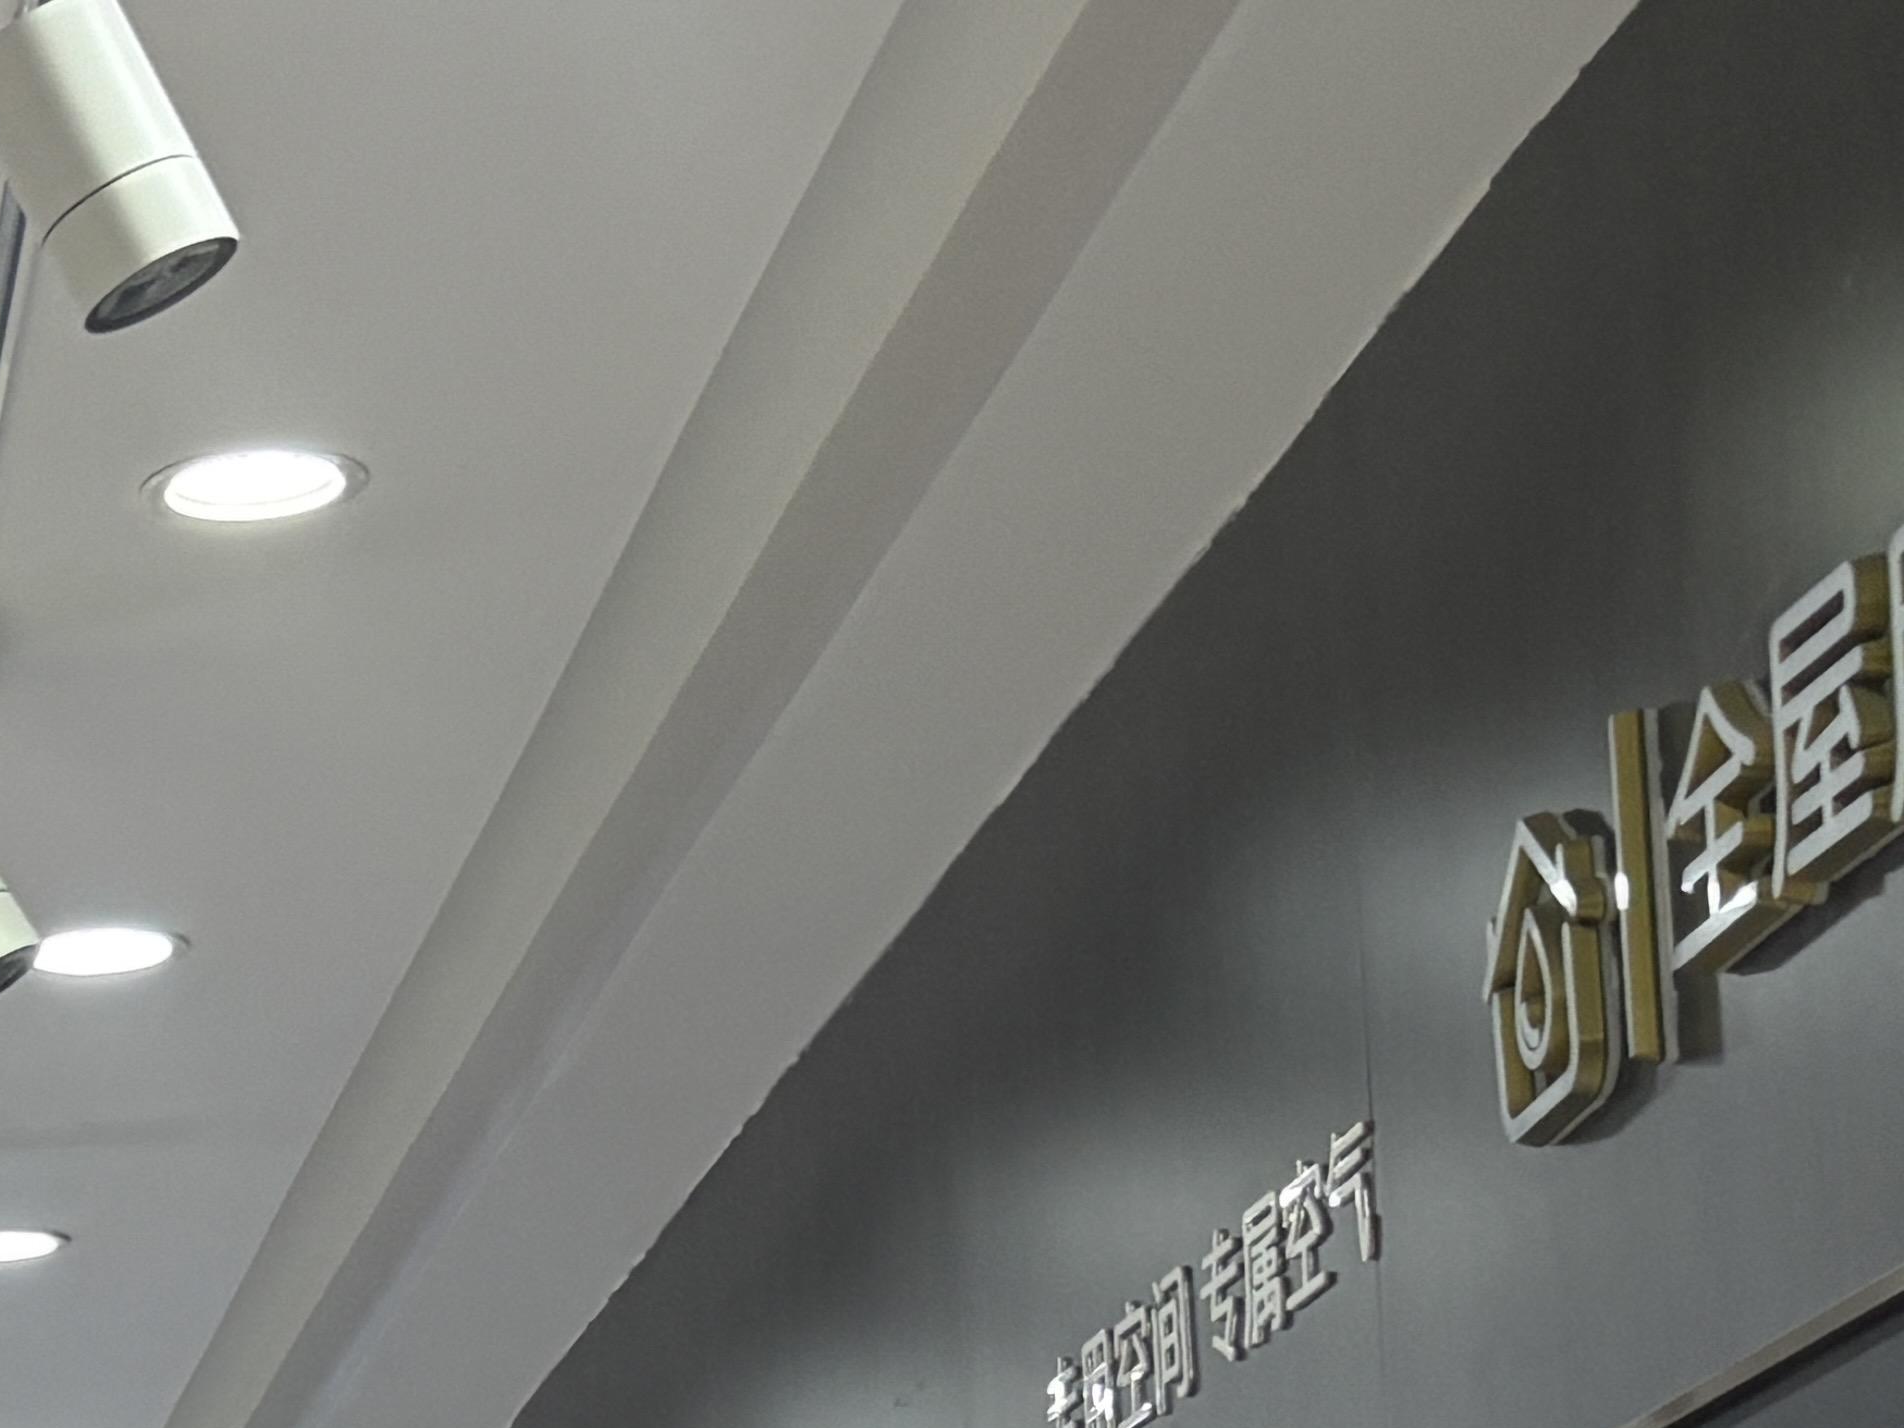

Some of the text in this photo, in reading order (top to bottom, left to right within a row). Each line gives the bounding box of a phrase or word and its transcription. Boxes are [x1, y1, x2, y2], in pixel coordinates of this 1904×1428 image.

[1666, 522, 1904, 972] 全屋
[1200, 1120, 1374, 1362] 专属空气
